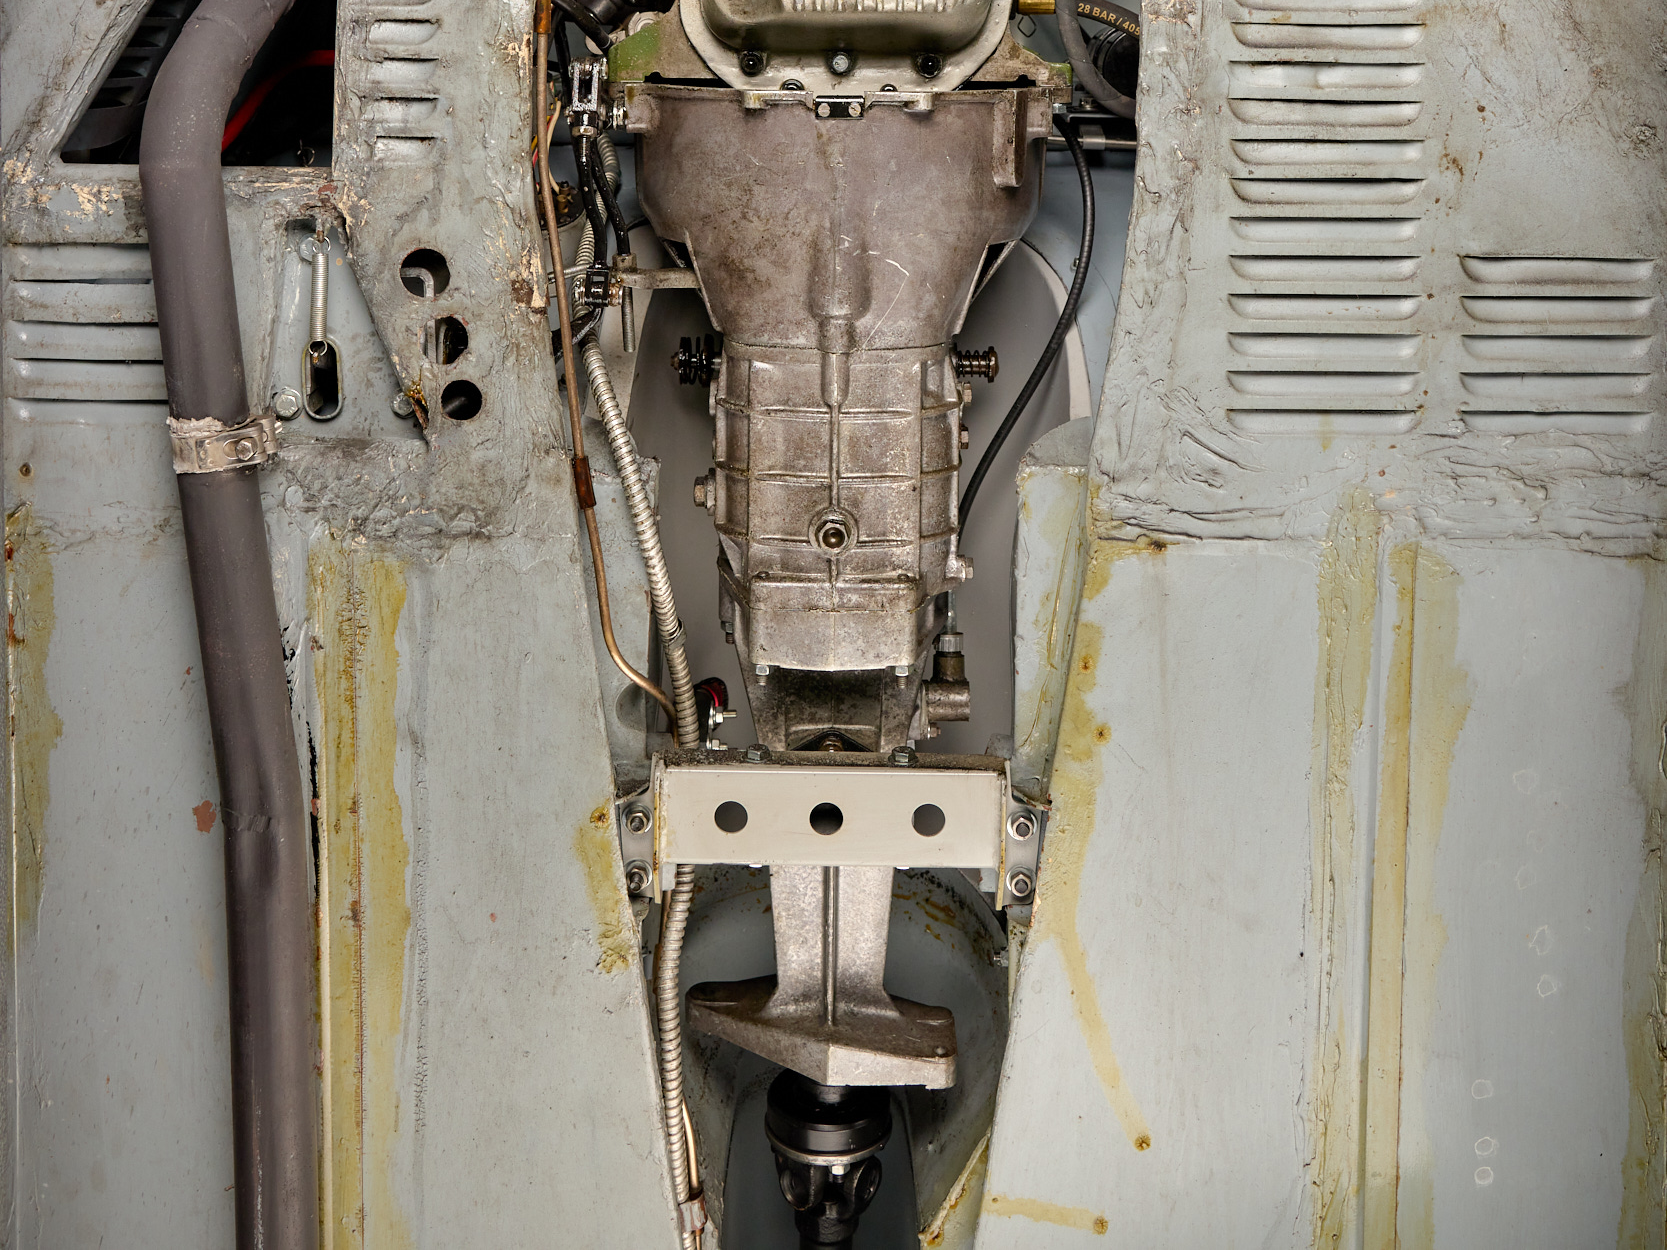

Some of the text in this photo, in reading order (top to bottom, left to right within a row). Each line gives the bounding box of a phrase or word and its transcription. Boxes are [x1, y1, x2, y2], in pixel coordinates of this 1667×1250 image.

[1077, 3, 1091, 14] 28
[1092, 7, 1117, 24] BAR
[1122, 21, 1140, 36] 405
